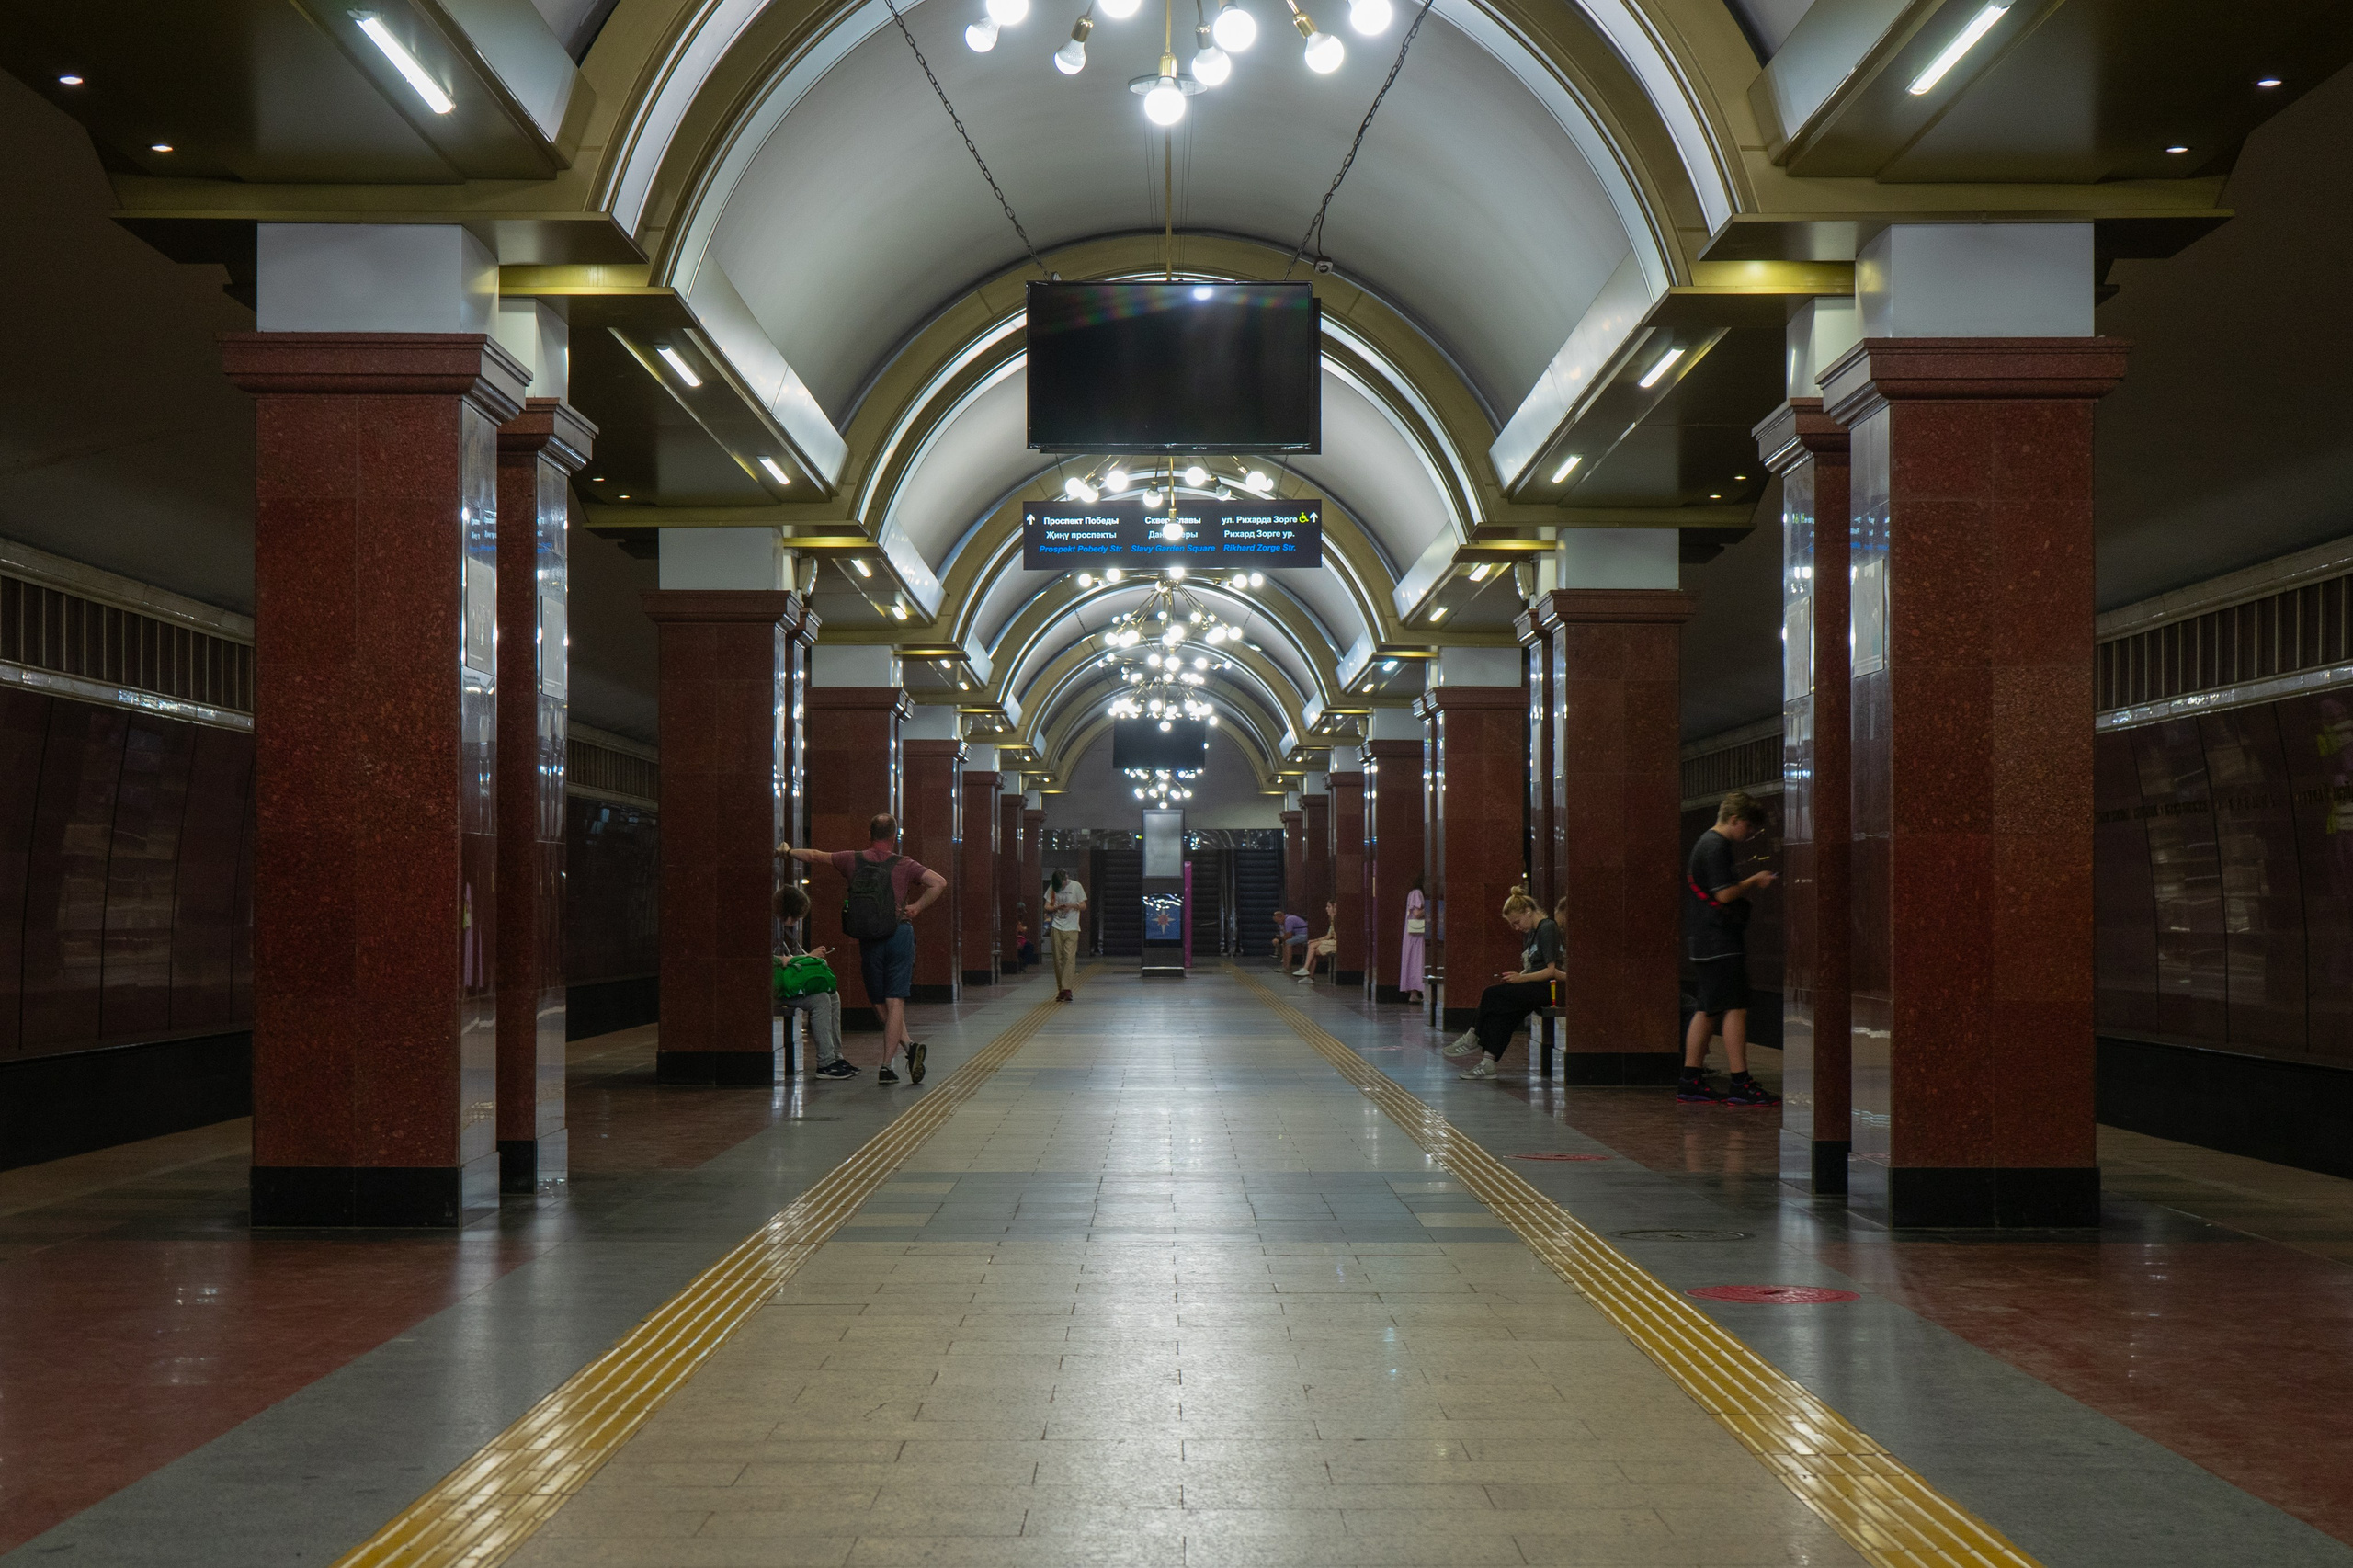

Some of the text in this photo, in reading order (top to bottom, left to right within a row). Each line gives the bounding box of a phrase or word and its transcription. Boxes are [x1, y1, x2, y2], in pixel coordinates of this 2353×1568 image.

[1043, 517, 1119, 526] Проспект Победы
[1144, 517, 1171, 525] Сквер
[1236, 517, 1272, 525] Рихарда
[1071, 531, 1117, 540] проспекты
[1224, 530, 1255, 539] Рихард
[1256, 530, 1281, 539] Зорге
[1039, 544, 1124, 554] Prospekt Pobedy Str.
[1131, 544, 1216, 553] Slavy Garden Square
[1223, 543, 1297, 552] Rikhard Zorge Str.
